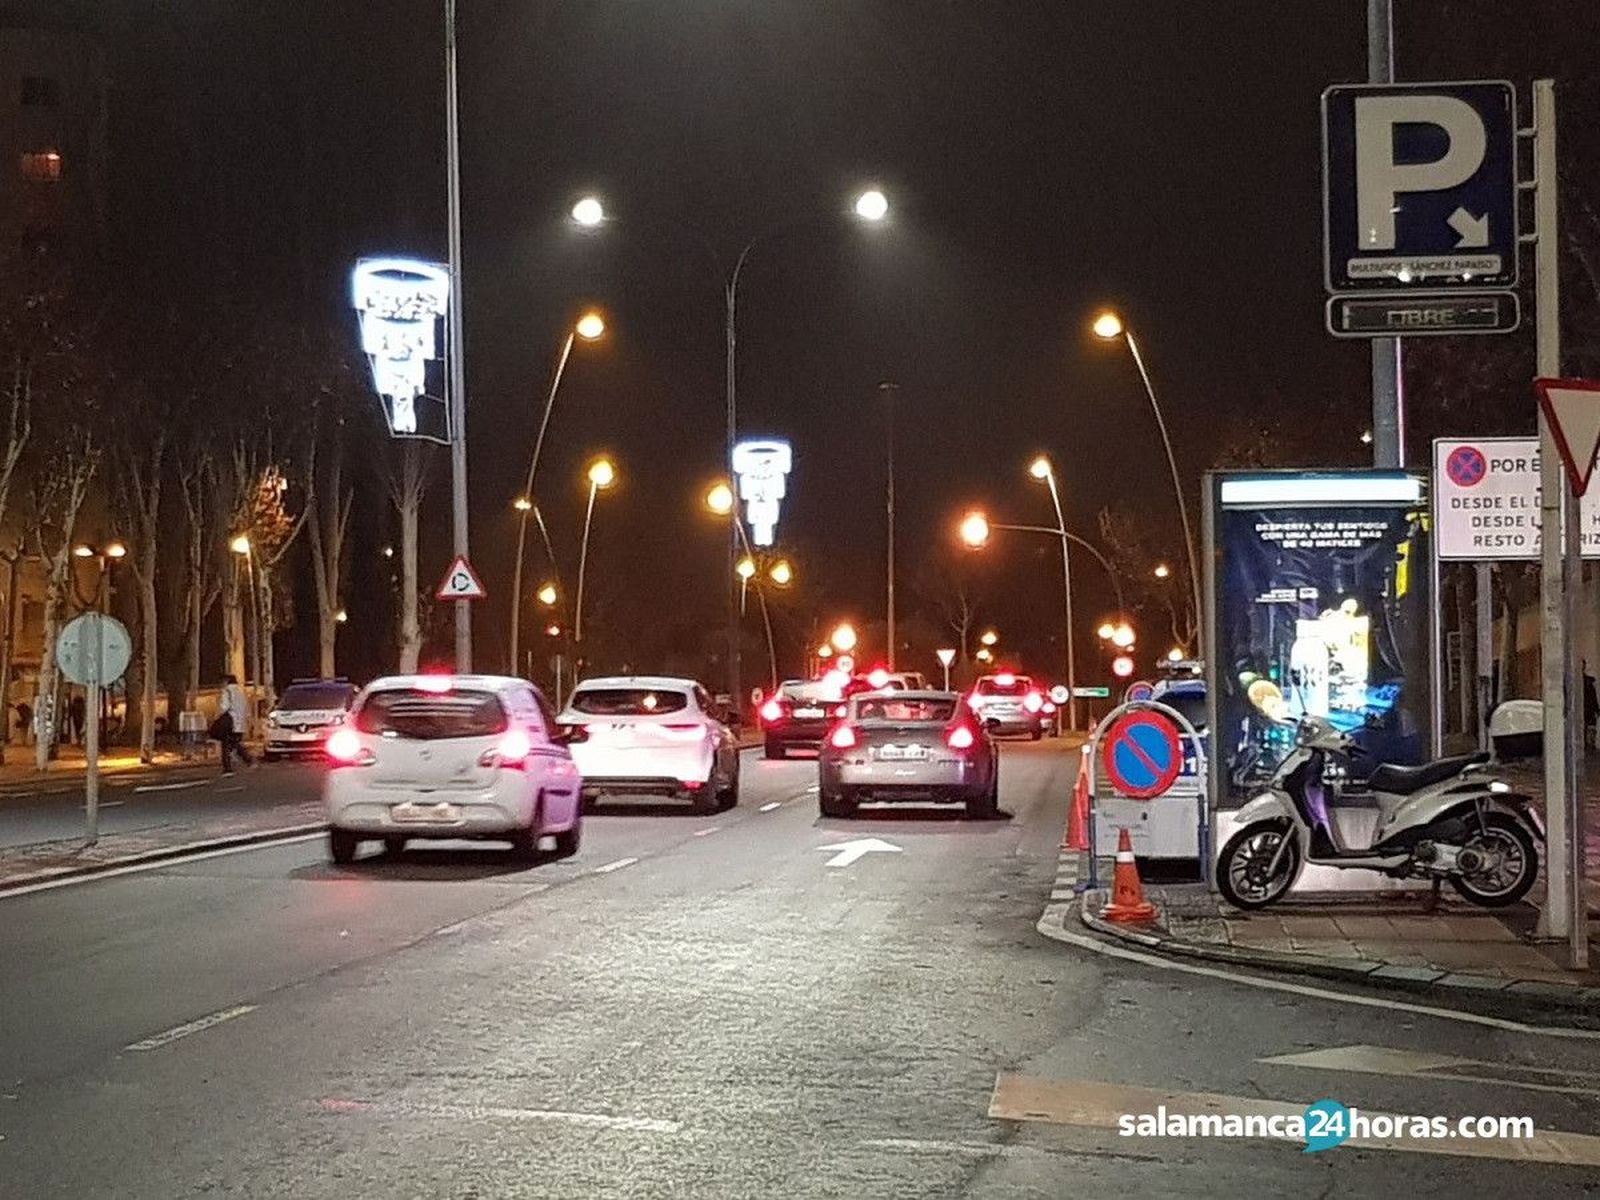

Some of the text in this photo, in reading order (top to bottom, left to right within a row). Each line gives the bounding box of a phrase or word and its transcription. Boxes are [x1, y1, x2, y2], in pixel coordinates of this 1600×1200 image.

[1355, 95, 1487, 250] P
[1491, 459, 1526, 472] POR
[1451, 497, 1502, 509] DESDE
[1510, 496, 1528, 508] EL
[1472, 516, 1525, 528] DESDE
[1473, 535, 1525, 547] RESTO
